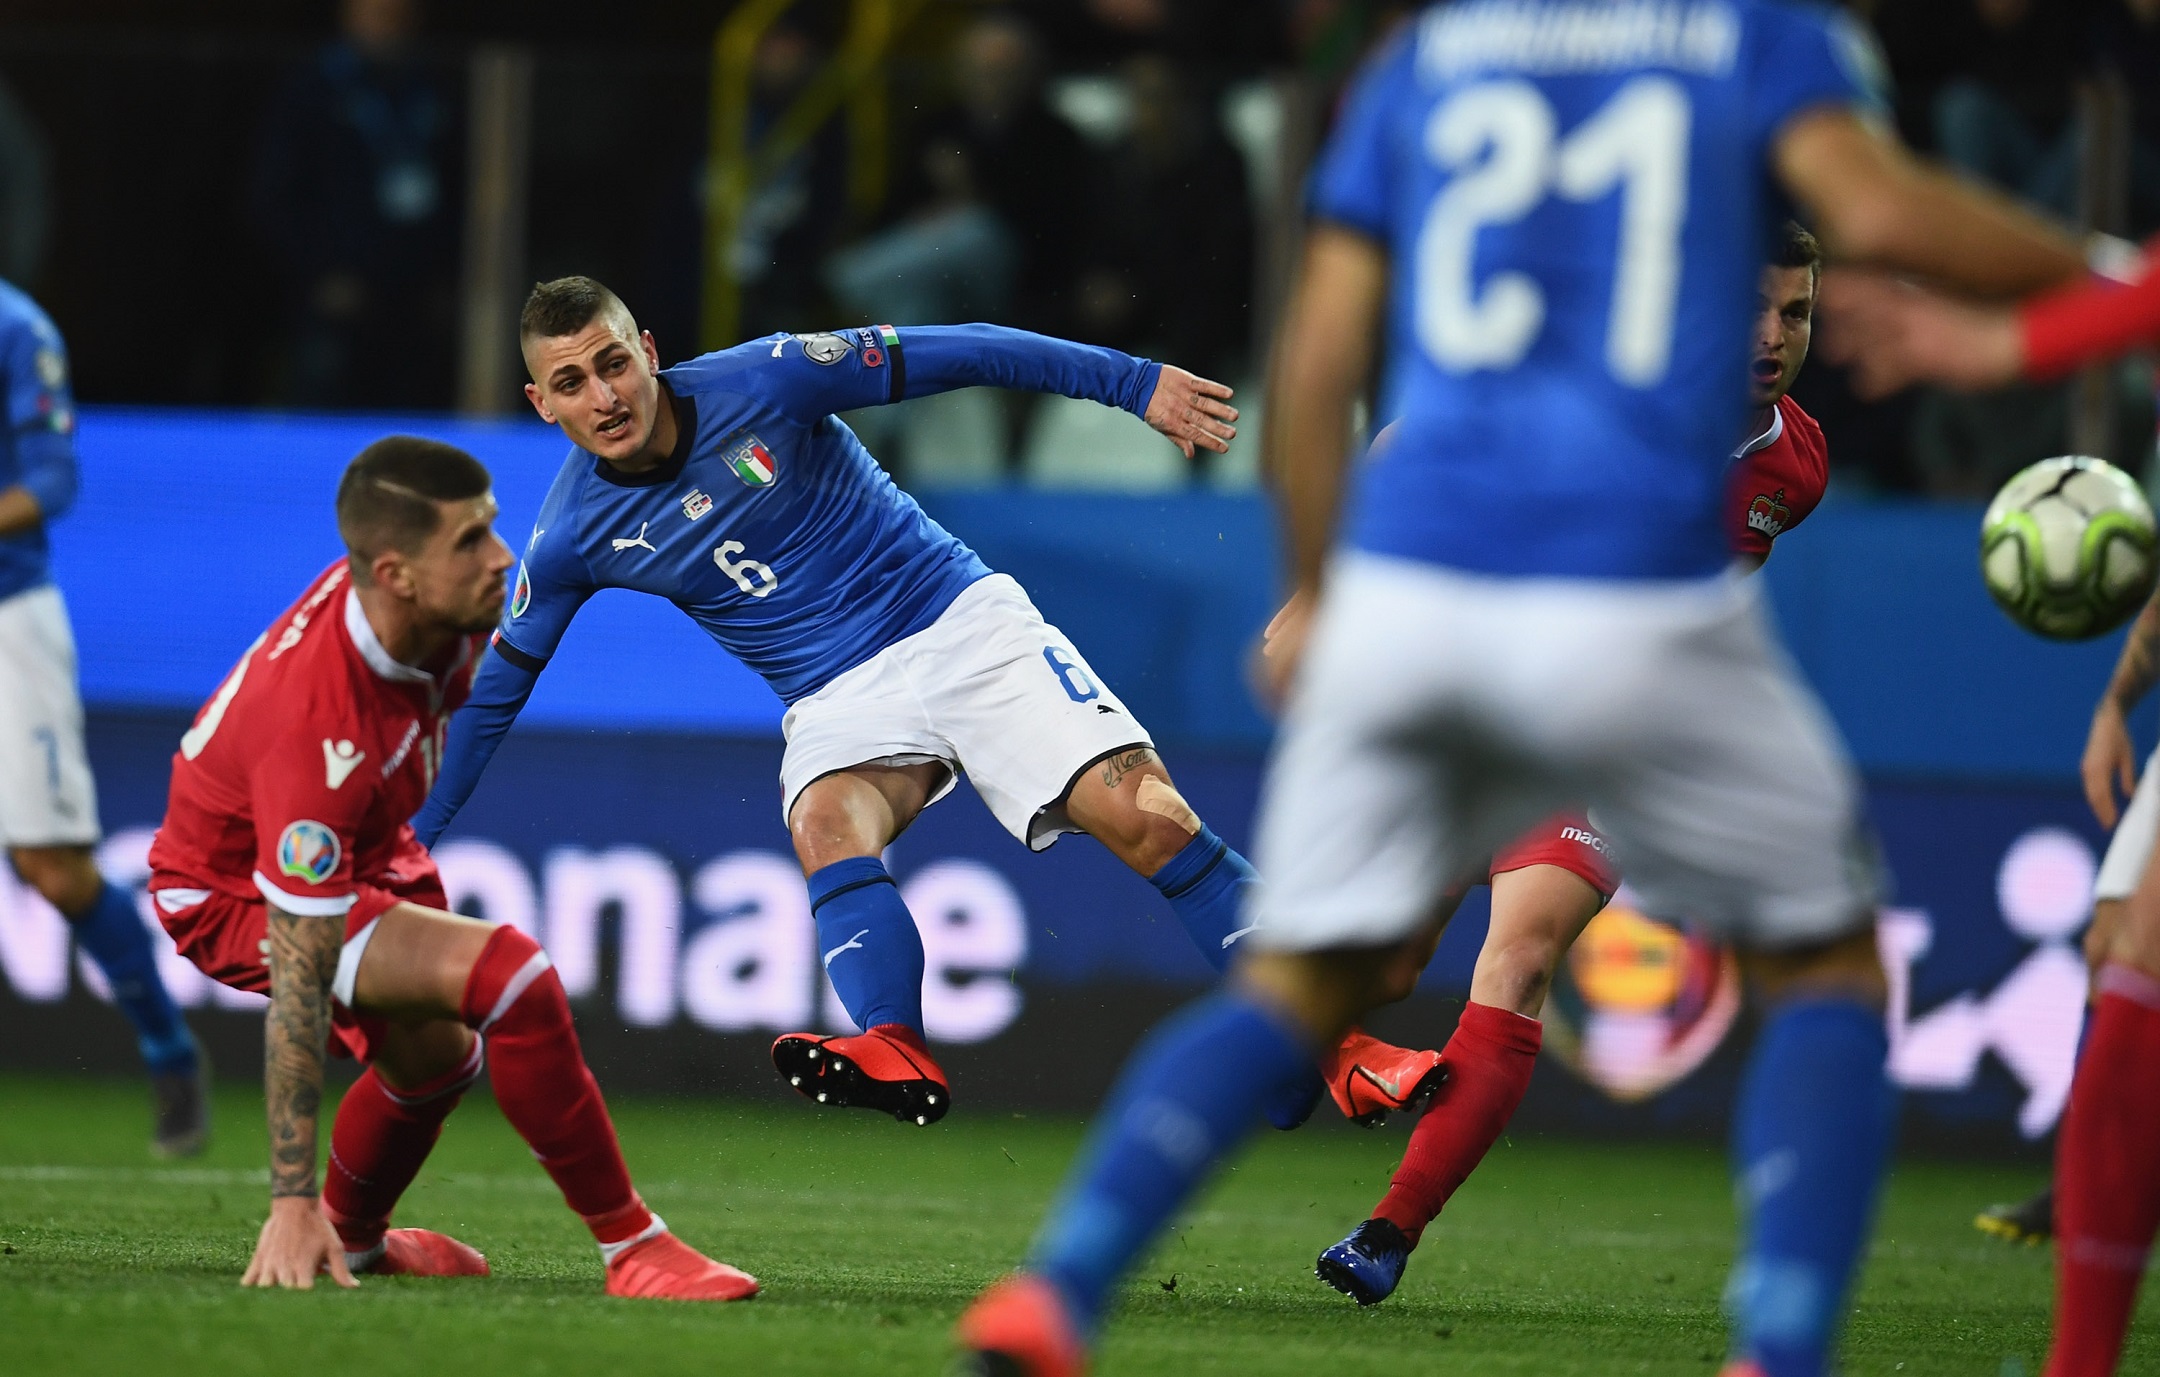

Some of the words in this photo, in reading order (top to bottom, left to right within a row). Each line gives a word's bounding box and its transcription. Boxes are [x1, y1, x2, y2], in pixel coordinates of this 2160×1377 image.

[1414, 75, 1692, 390] 21
[858, 328, 876, 348] RES
[713, 540, 778, 598] 6
[1043, 646, 1100, 704] 6
